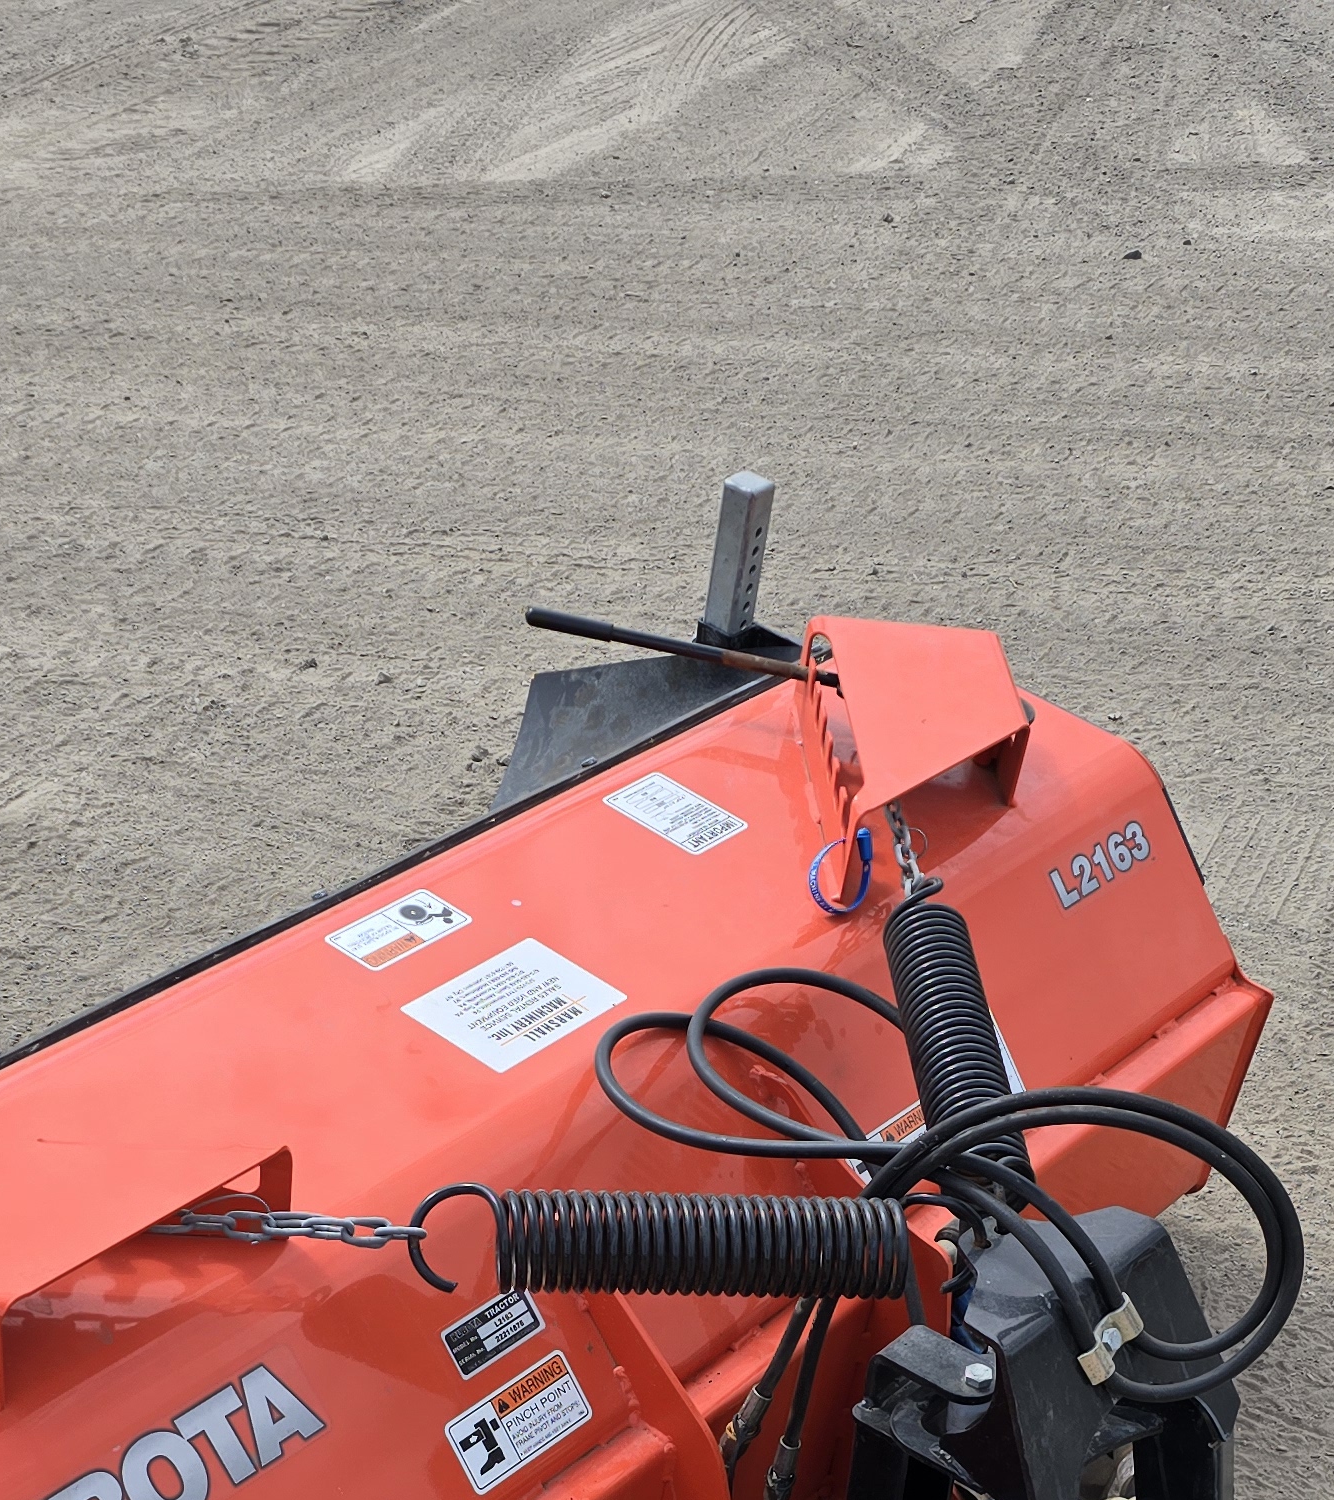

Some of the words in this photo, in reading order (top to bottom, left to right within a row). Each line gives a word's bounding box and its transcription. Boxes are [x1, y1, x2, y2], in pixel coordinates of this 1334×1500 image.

[686, 818, 738, 848] IMPORTANT
[1049, 820, 1151, 910] L2163
[525, 984, 544, 995] AND
[536, 983, 562, 999] SALES
[540, 975, 559, 987] NEW
[506, 993, 528, 1006] USED
[509, 996, 540, 1014] RENTAL
[465, 1004, 509, 1029] EQUIPMENT
[479, 1011, 513, 1031] SERVICE
[504, 995, 568, 1033] MACHINERY,
[521, 1005, 584, 1042] MARSHALL
[486, 1027, 513, 1044] Inc.
[894, 1108, 925, 1137] WARN
[483, 1292, 520, 1319] TRACTOR
[507, 1358, 563, 1405] WARNING
[505, 1402, 540, 1432] PINCH
[539, 1379, 572, 1408] POINT
[511, 1425, 528, 1440] AVOID
[528, 1412, 547, 1428] INJURY
[546, 1401, 562, 1415] FROM
[515, 1431, 535, 1449] FRAME
[533, 1420, 550, 1435] PIVOT
[549, 1412, 562, 1424] AND
